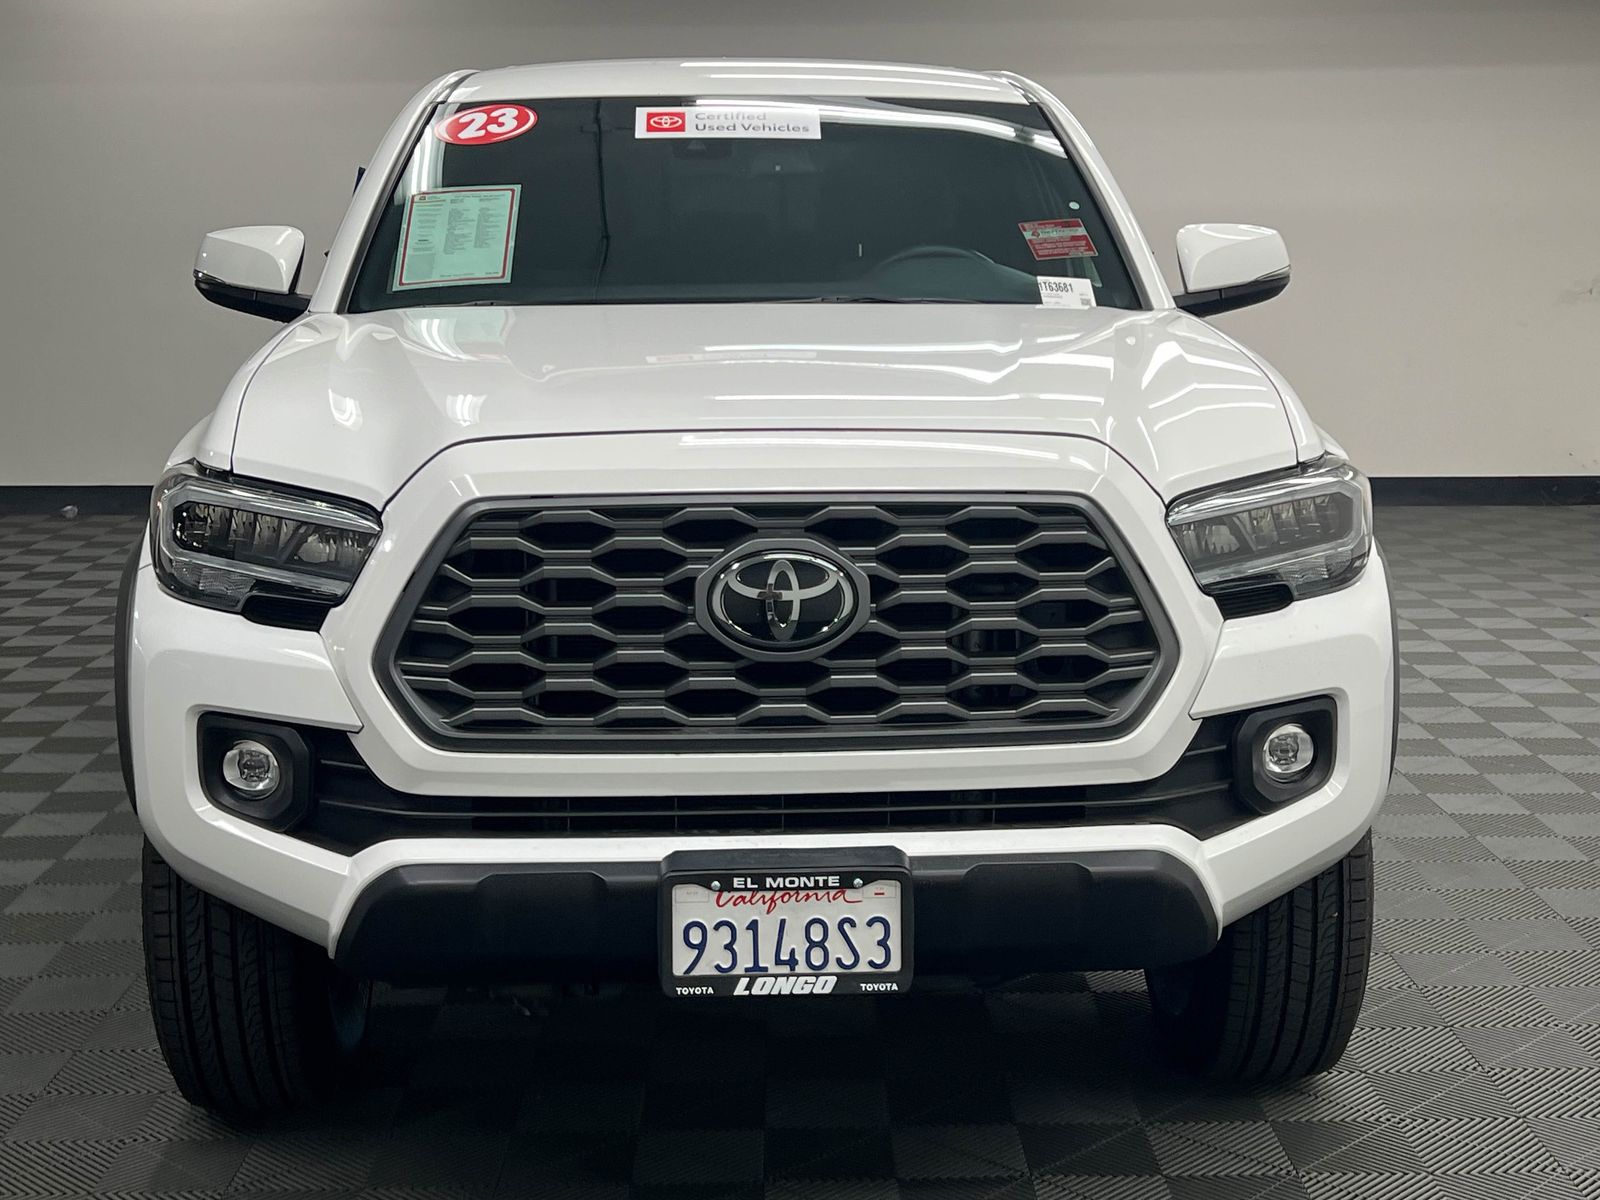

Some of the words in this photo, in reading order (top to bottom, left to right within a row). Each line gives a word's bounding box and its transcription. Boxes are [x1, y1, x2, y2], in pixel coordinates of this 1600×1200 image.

[695, 112, 767, 121] Certified
[457, 107, 519, 140] 23
[695, 123, 737, 132] Used
[742, 123, 810, 133] Vehicles
[732, 877, 753, 889] EL
[765, 876, 840, 889] MONTE
[715, 888, 863, 915] California
[682, 916, 892, 975] 93148S3
[676, 986, 714, 995] TOYOTA
[733, 975, 838, 996] LONGO
[860, 982, 899, 992] TOYOTA
